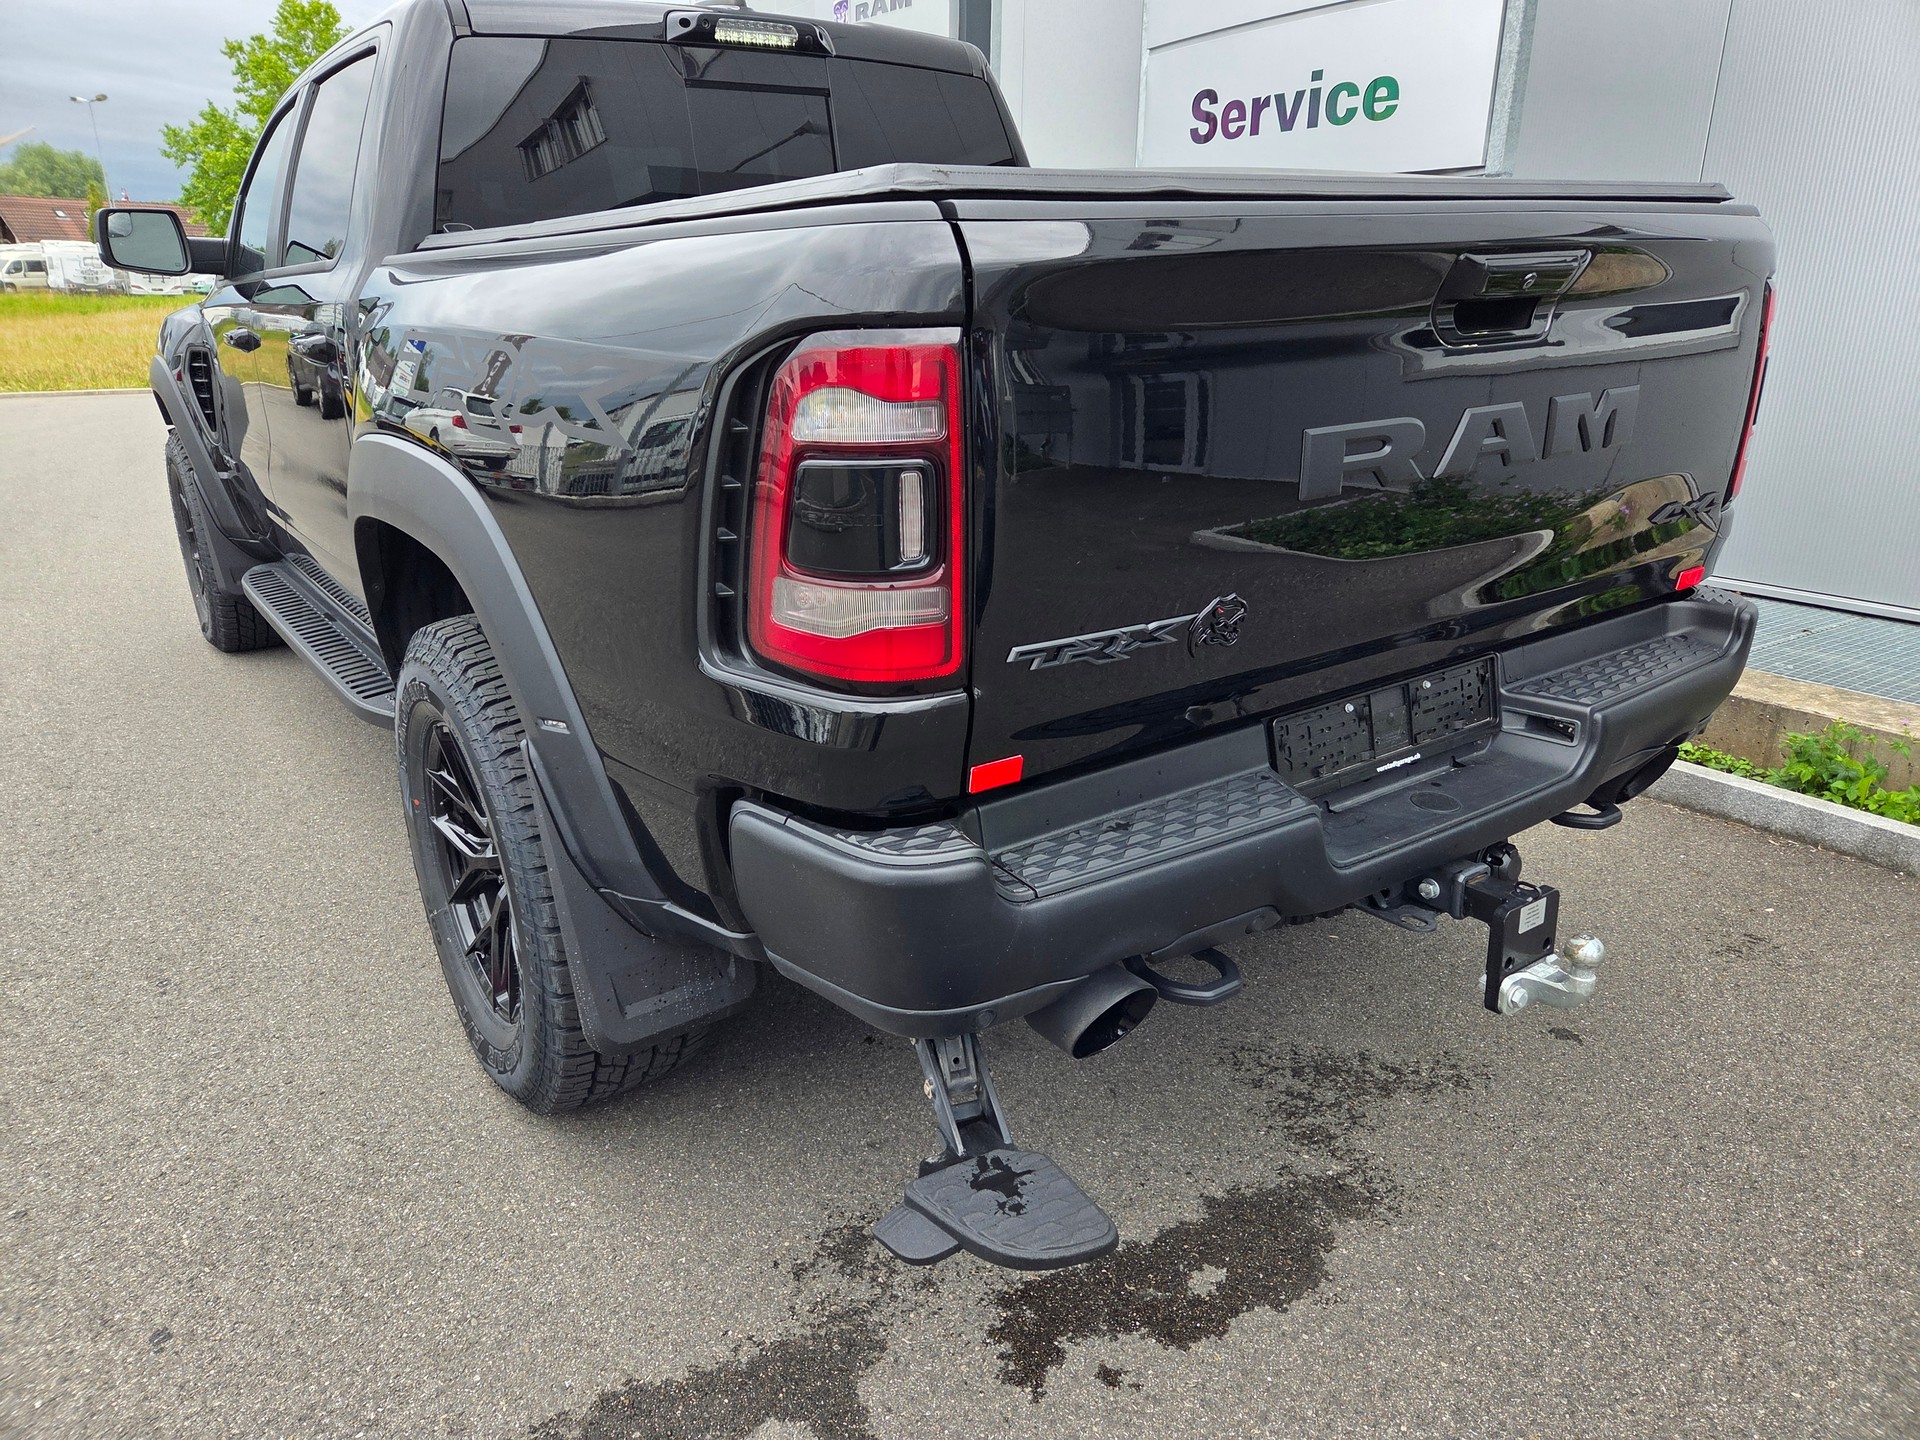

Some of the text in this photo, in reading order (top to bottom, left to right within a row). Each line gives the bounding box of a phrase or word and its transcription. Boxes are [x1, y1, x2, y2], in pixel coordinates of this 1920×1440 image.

[855, 0, 913, 21] RAM
[1189, 69, 1400, 145] Service
[1298, 384, 1640, 500] RAM
[1006, 613, 1199, 671] TRX
